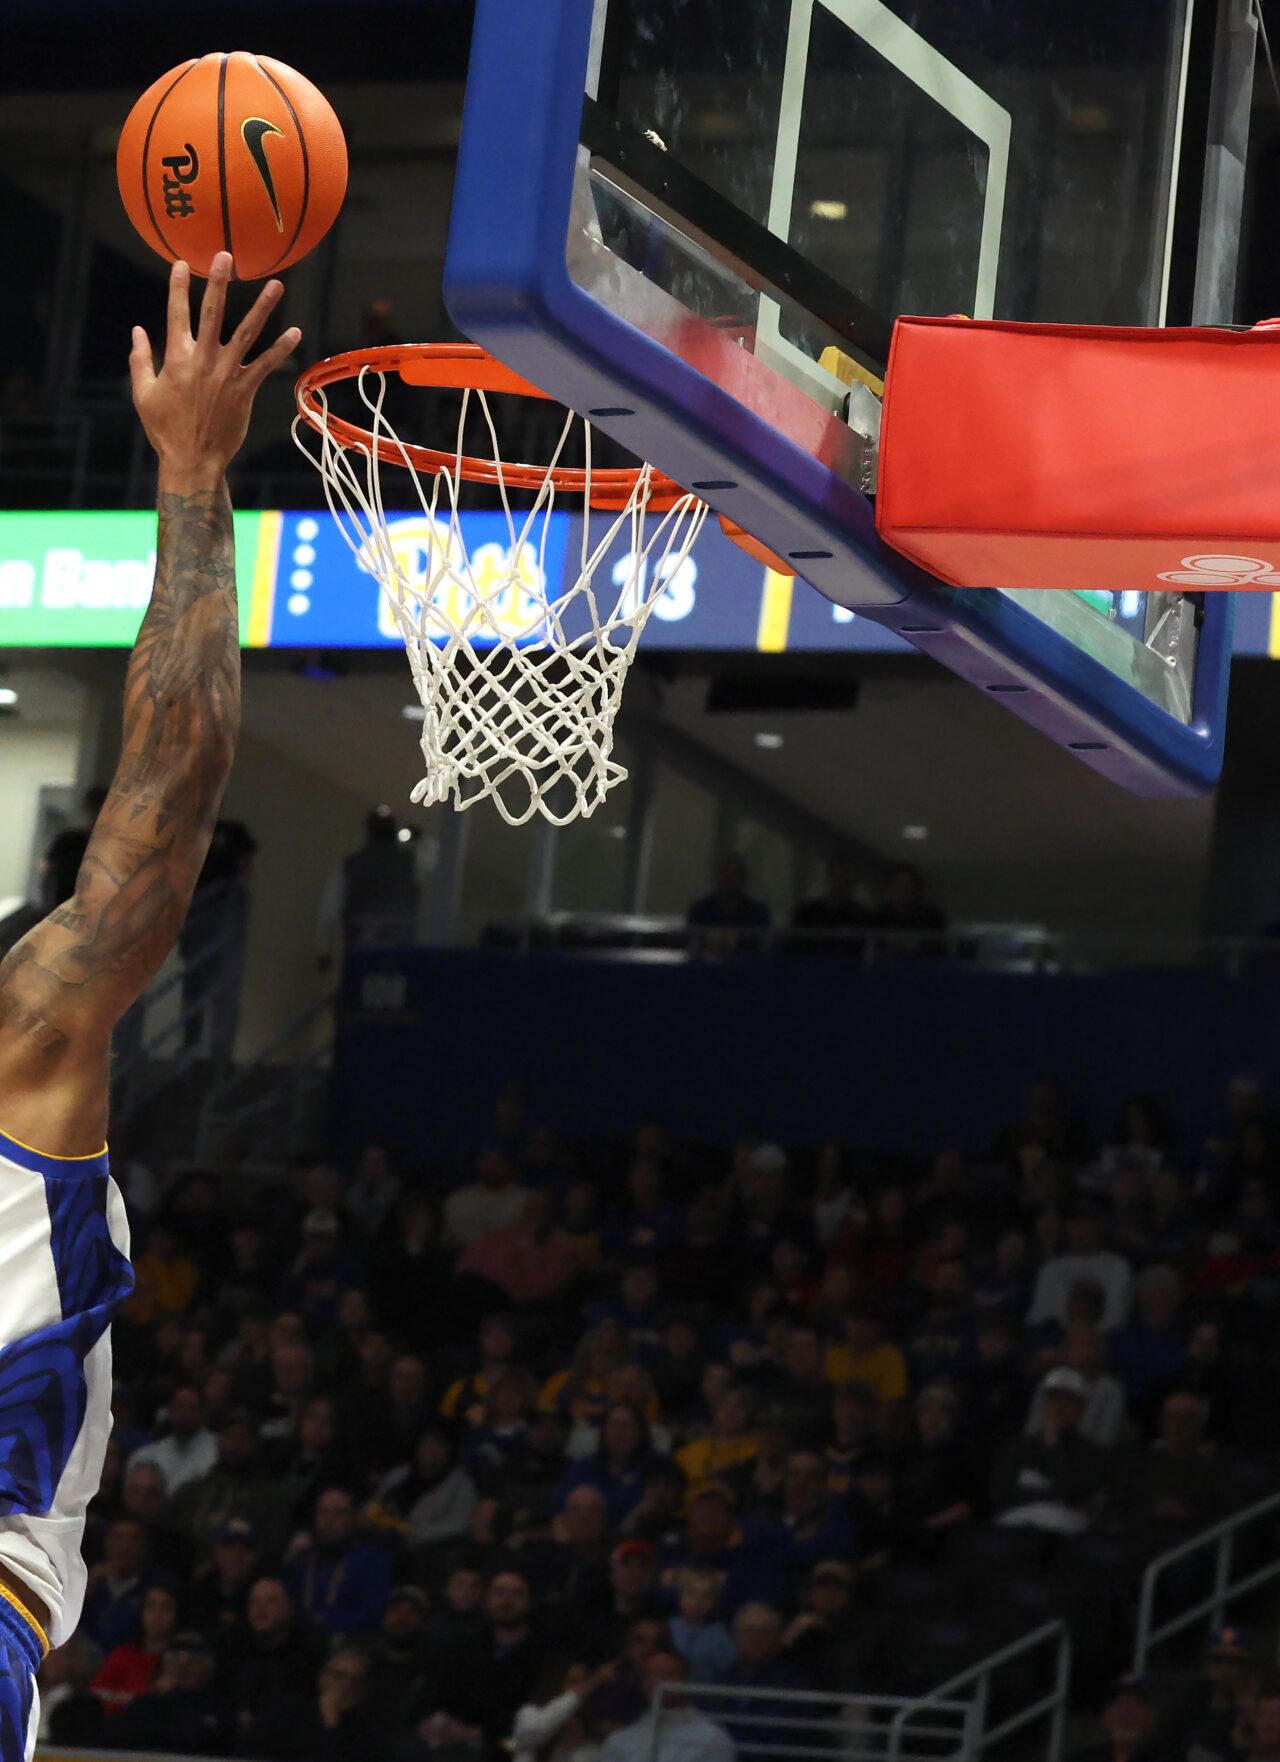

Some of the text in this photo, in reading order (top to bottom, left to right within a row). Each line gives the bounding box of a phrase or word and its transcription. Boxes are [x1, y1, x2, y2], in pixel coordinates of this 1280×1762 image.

[162, 143, 200, 219] Pitt
[41, 548, 157, 608] Ban
[612, 551, 698, 622] 13
